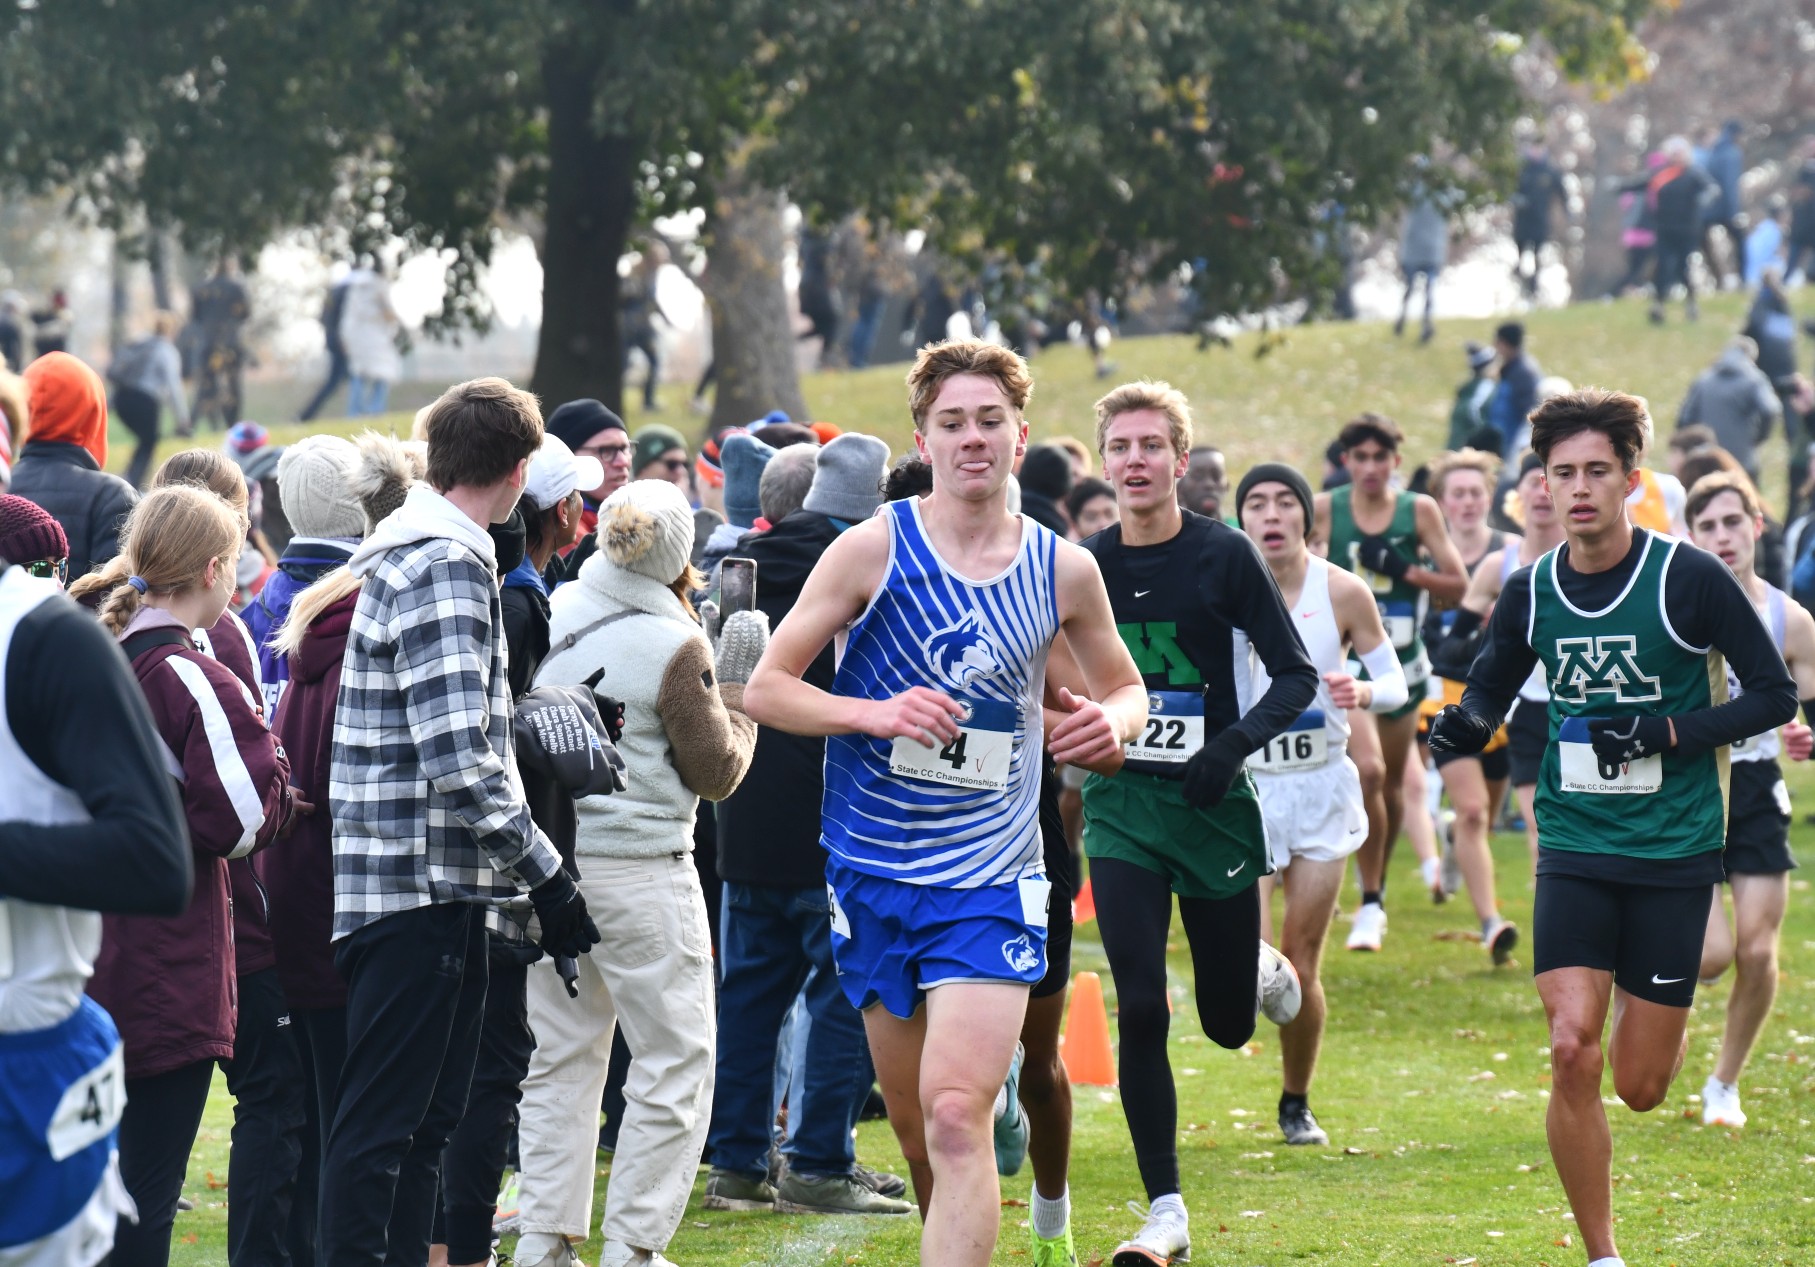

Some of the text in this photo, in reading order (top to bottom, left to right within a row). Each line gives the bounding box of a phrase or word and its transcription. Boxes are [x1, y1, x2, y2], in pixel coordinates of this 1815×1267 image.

[533, 712, 542, 728] Clara
[540, 707, 558, 755] Kendra Melby
[550, 706, 567, 754] Clara Sennott
[559, 706, 575, 752] Leah Leckner
[575, 729, 585, 751] Brady
[940, 732, 968, 770] 4
[1144, 752, 1192, 760] Championship
[897, 764, 999, 788] State CC Championships
[1599, 783, 1654, 792] Championships
